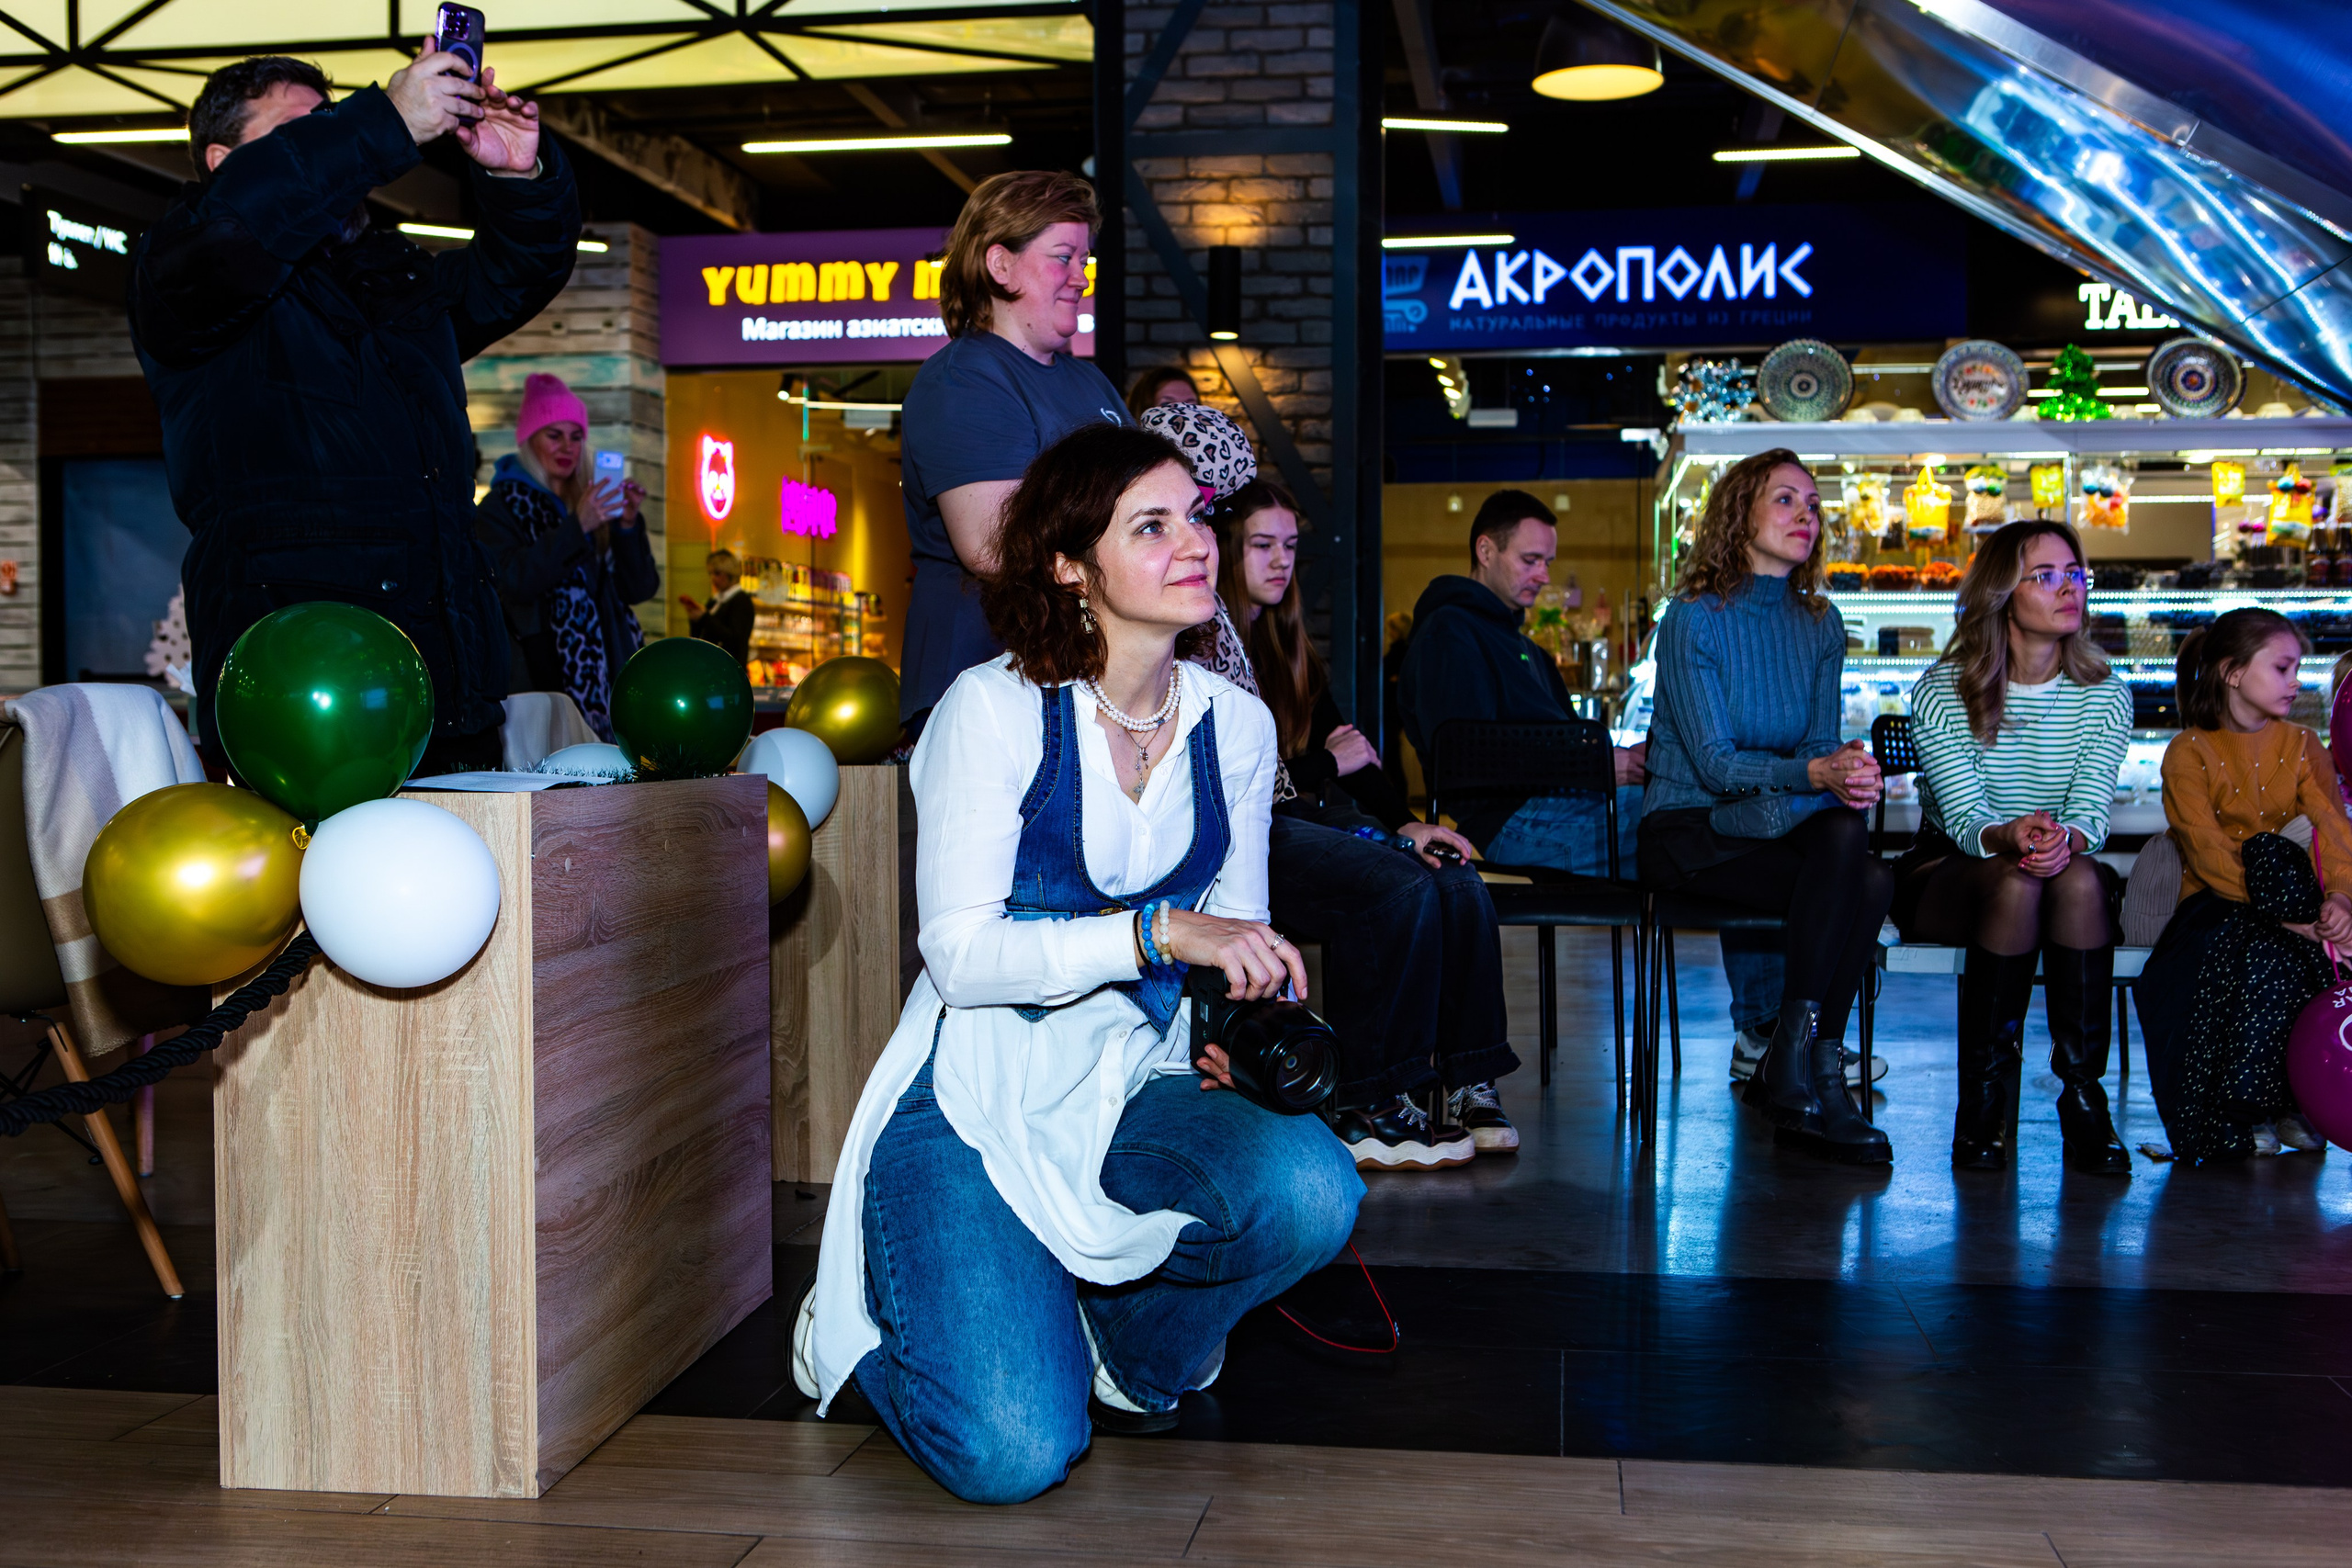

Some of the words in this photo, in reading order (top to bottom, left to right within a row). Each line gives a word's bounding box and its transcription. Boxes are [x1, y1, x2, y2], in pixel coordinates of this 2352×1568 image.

[1449, 242, 1815, 310] АКРОПОЛИС
[1449, 313, 1586, 333] НАТУРАЛЬНЫЕ
[1595, 311, 1697, 331] ПРОДУКТЫ
[1706, 310, 1730, 327] ИЗ
[1739, 308, 1812, 327] ГРЕЦИИ
[2078, 283, 2181, 330] TAL
[741, 317, 843, 341] Магазин
[845, 317, 949, 338] азиатски
